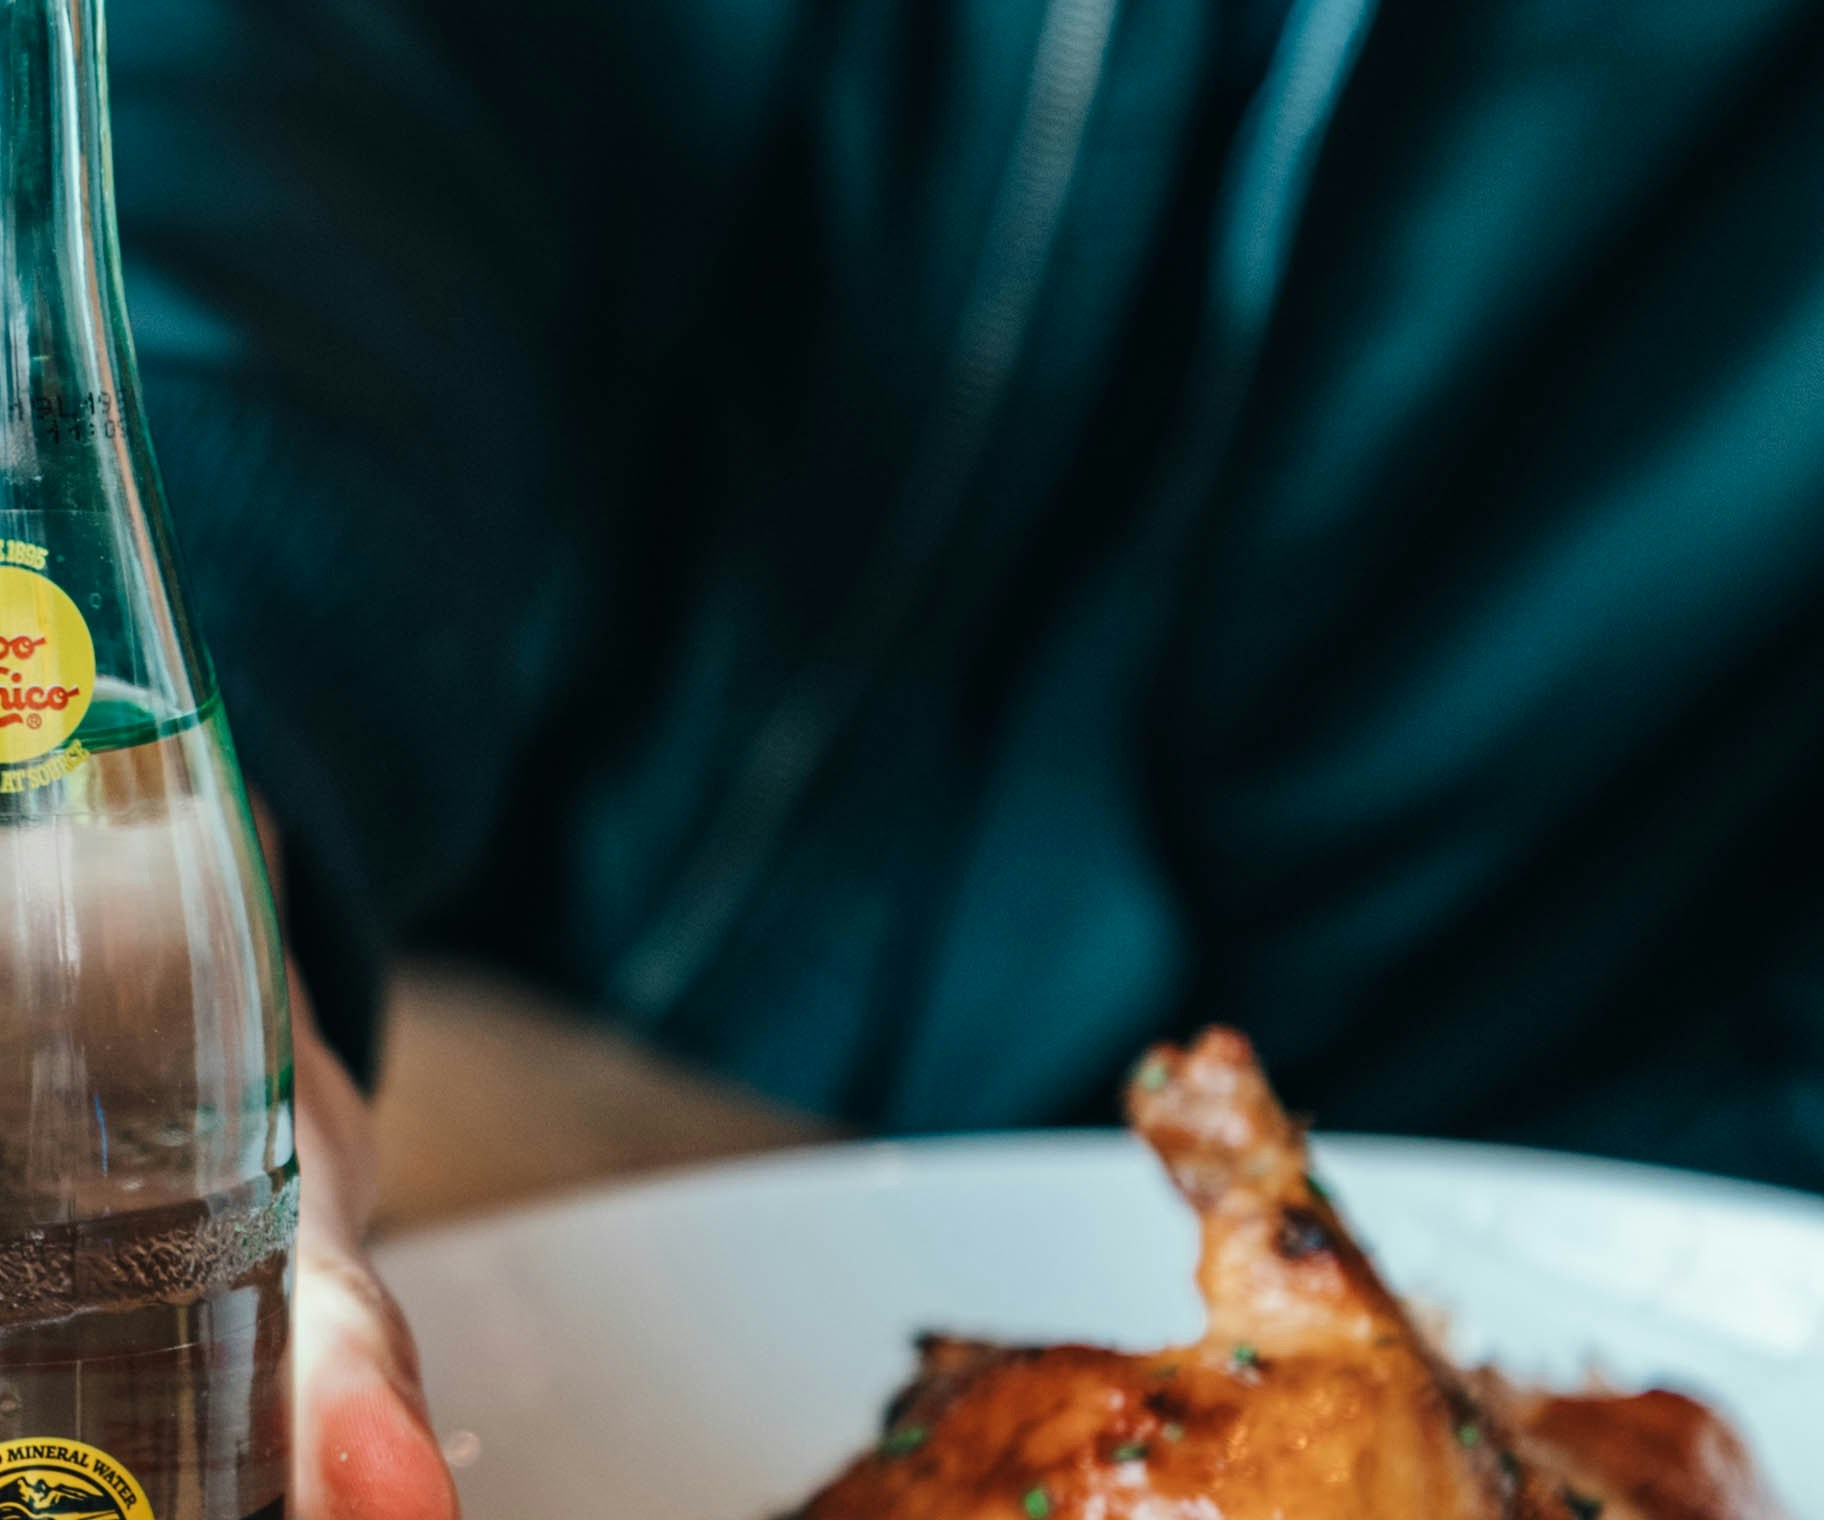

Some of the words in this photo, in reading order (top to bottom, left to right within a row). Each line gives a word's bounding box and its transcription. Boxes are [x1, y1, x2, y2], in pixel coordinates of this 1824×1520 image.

[6, 539, 49, 570] 1895
[0, 769, 25, 794] AT
[27, 738, 90, 790] SOURCE
[7, 1445, 90, 1469] MINERAL
[91, 1458, 138, 1512] WATER
